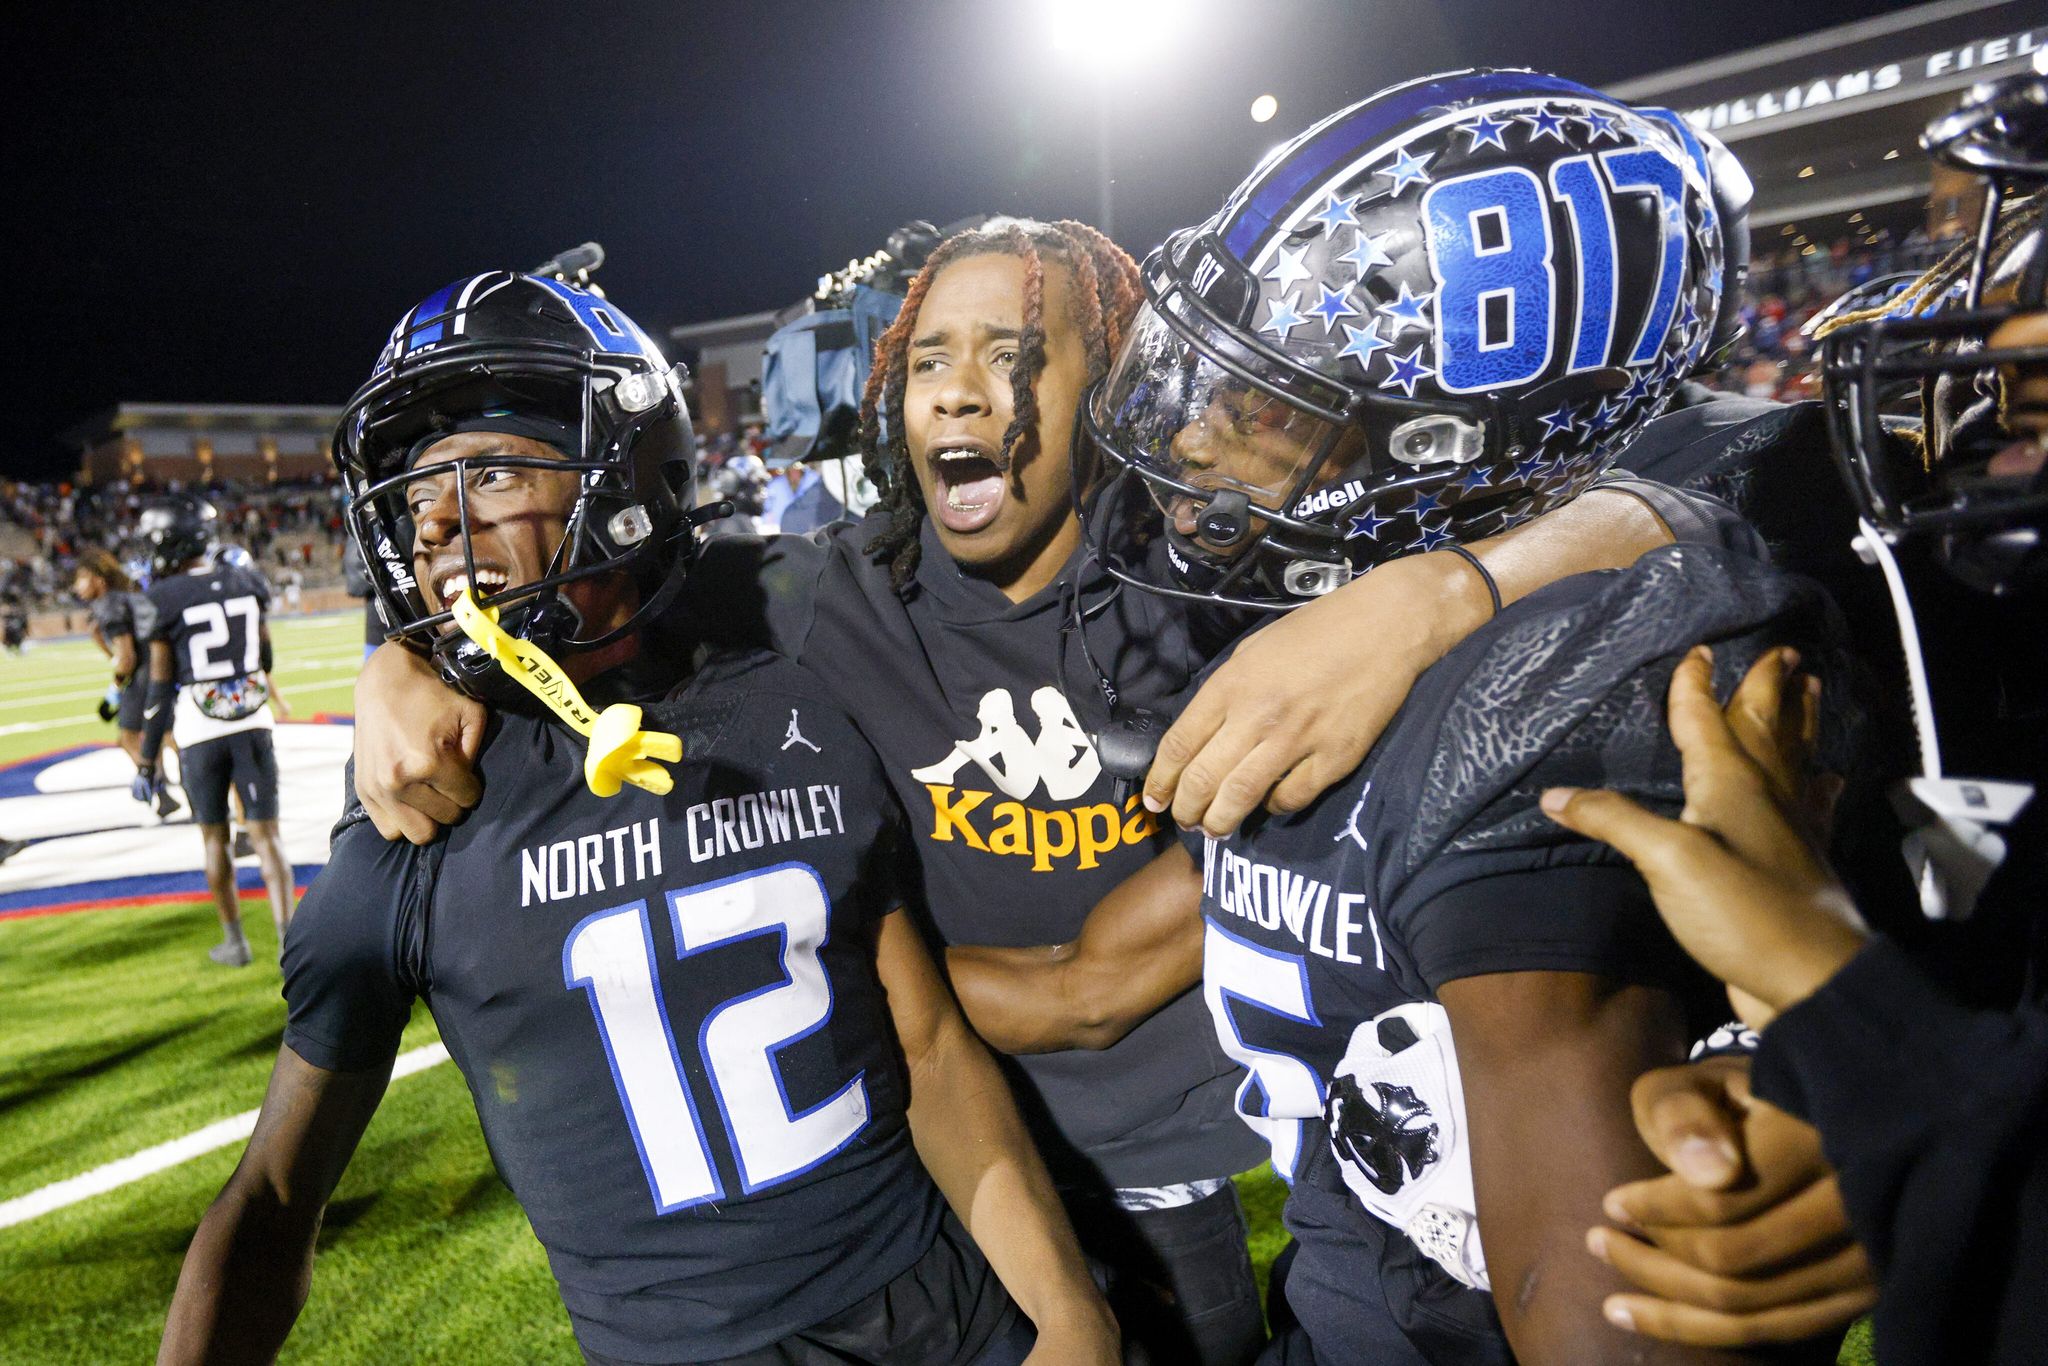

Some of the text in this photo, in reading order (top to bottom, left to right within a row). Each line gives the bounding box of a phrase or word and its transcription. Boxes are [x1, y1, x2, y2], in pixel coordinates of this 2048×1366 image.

[1926, 32, 2043, 78] FIEL
[1191, 252, 1226, 298] 817
[1420, 150, 1690, 395] 817
[182, 594, 261, 681] 27
[520, 784, 846, 908] NORTH CROWLEY
[925, 783, 1160, 872] Kappa
[562, 860, 871, 1216] 12
